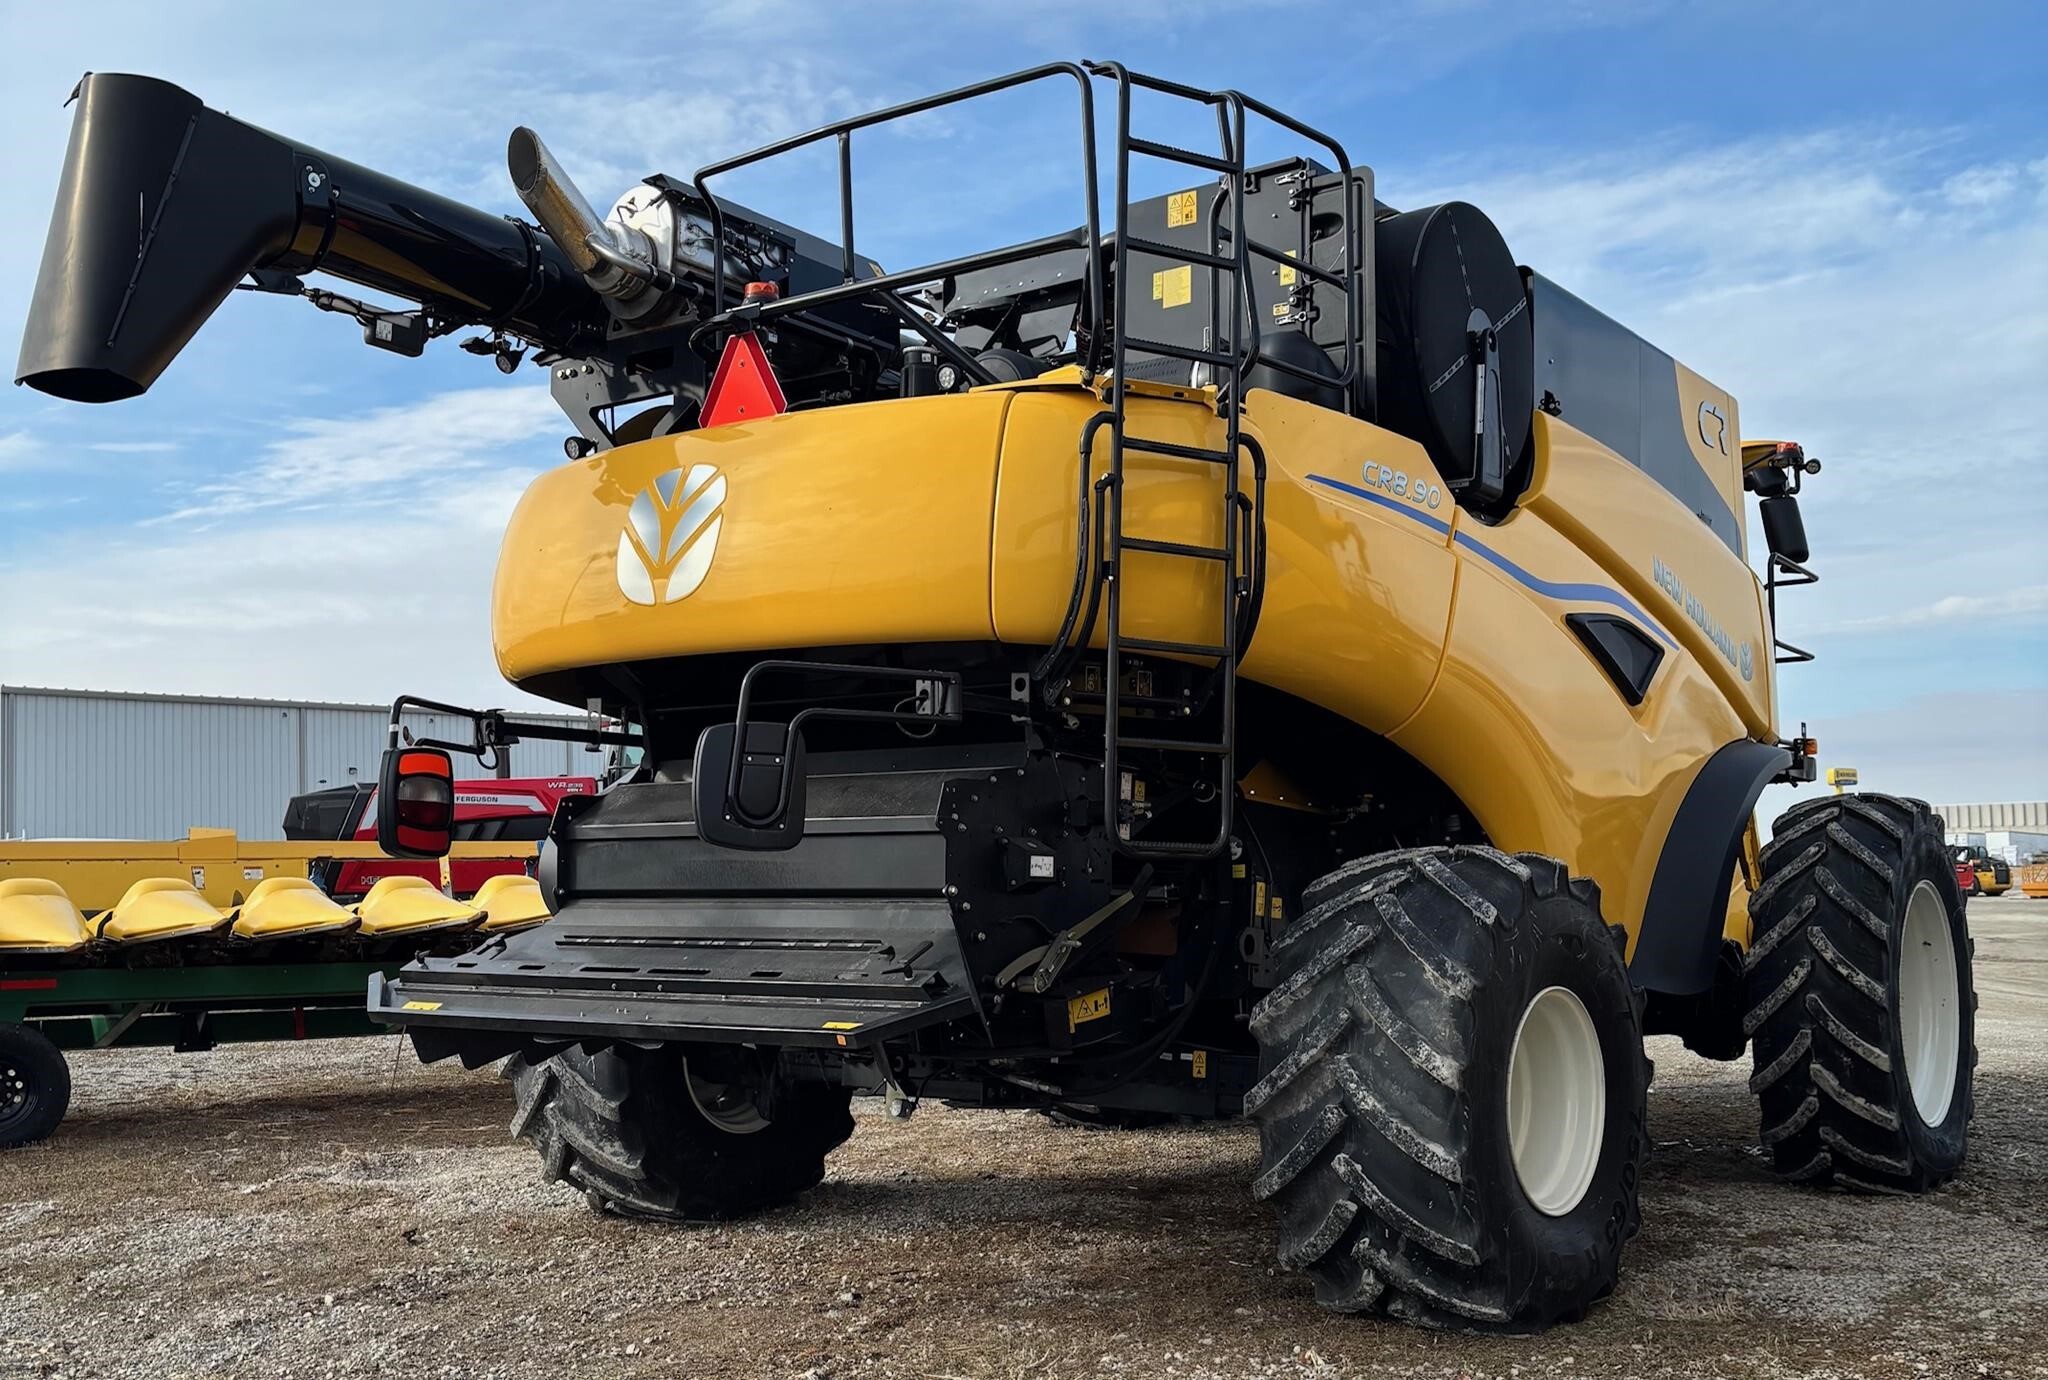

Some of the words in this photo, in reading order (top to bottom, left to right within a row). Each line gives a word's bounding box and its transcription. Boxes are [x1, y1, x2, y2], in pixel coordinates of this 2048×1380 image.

[1362, 460, 1441, 509] CR8.90
[1653, 554, 1683, 607] NEW
[1685, 588, 1738, 668] HOLLAND
